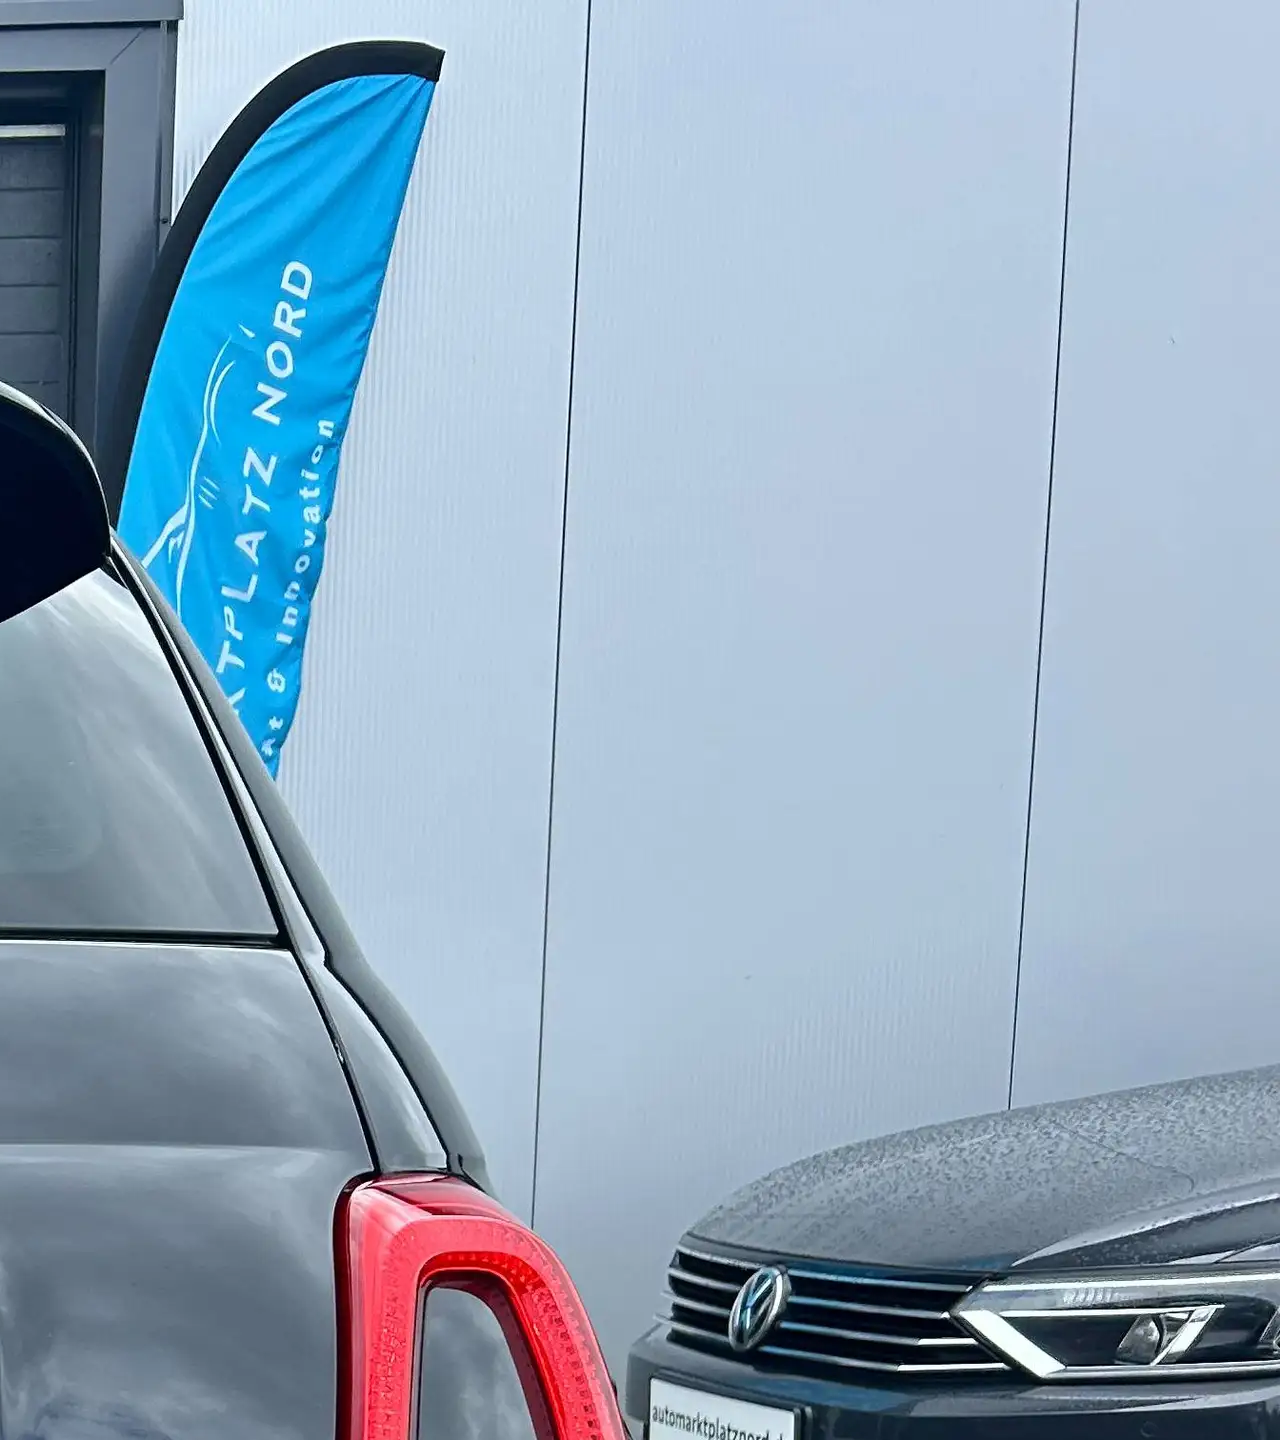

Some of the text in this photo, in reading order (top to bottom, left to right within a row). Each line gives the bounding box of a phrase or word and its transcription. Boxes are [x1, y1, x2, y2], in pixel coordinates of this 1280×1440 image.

[215, 260, 313, 714] TPLATZ NORD
[275, 419, 335, 645] Innovation
